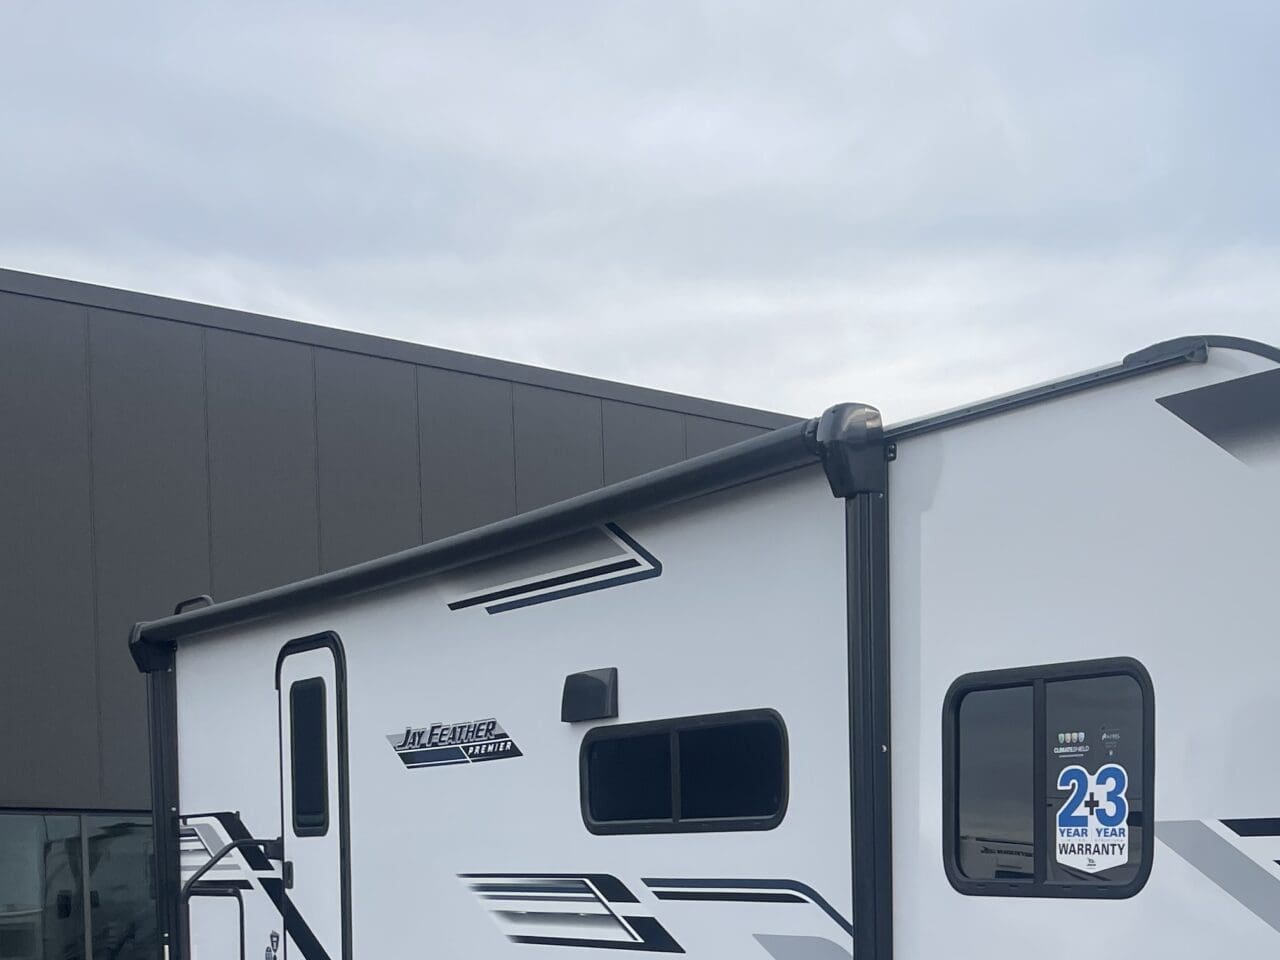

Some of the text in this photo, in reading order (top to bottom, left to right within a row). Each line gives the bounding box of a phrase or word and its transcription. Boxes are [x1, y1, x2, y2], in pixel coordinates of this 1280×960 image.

[397, 720, 498, 750] JAY FEATHER
[468, 741, 512, 755] PREMIER
[1059, 828, 1126, 838] YEAR YEAR
[1058, 843, 1126, 856] WARRANTY
